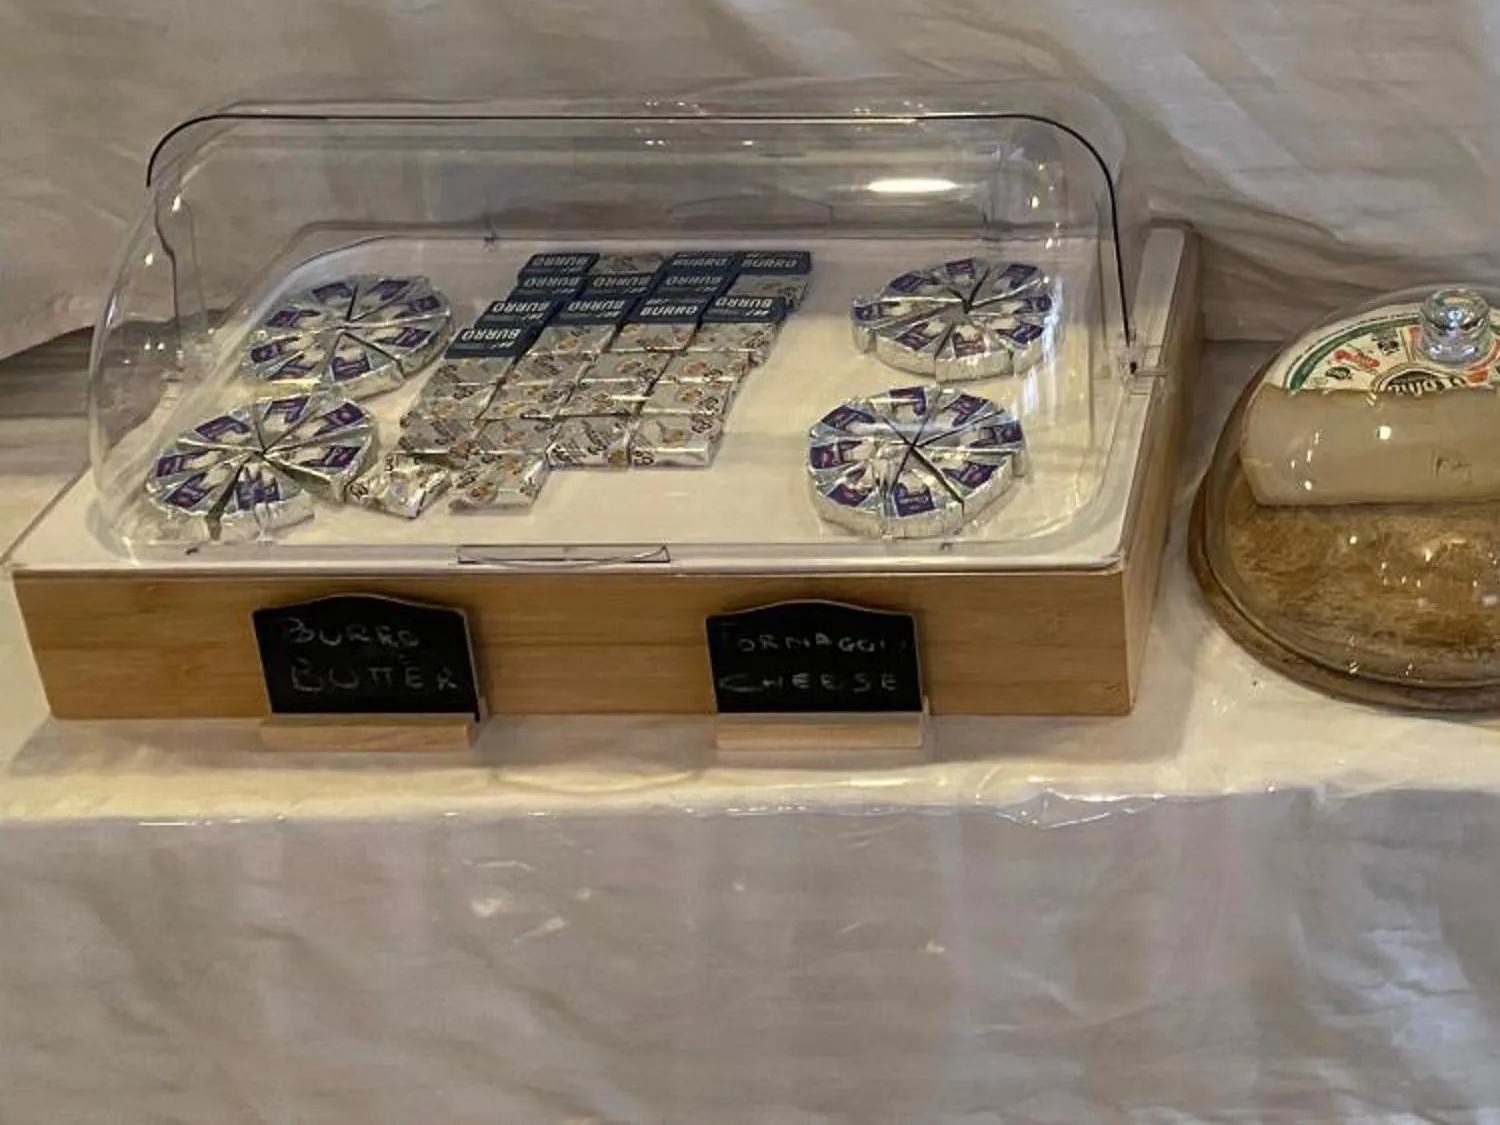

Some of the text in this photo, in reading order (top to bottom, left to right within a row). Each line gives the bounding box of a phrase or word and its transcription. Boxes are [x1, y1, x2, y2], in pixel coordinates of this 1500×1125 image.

[715, 297, 773, 309] BURRO
[461, 327, 522, 341] BURRO
[290, 655, 459, 693] BUTTER
